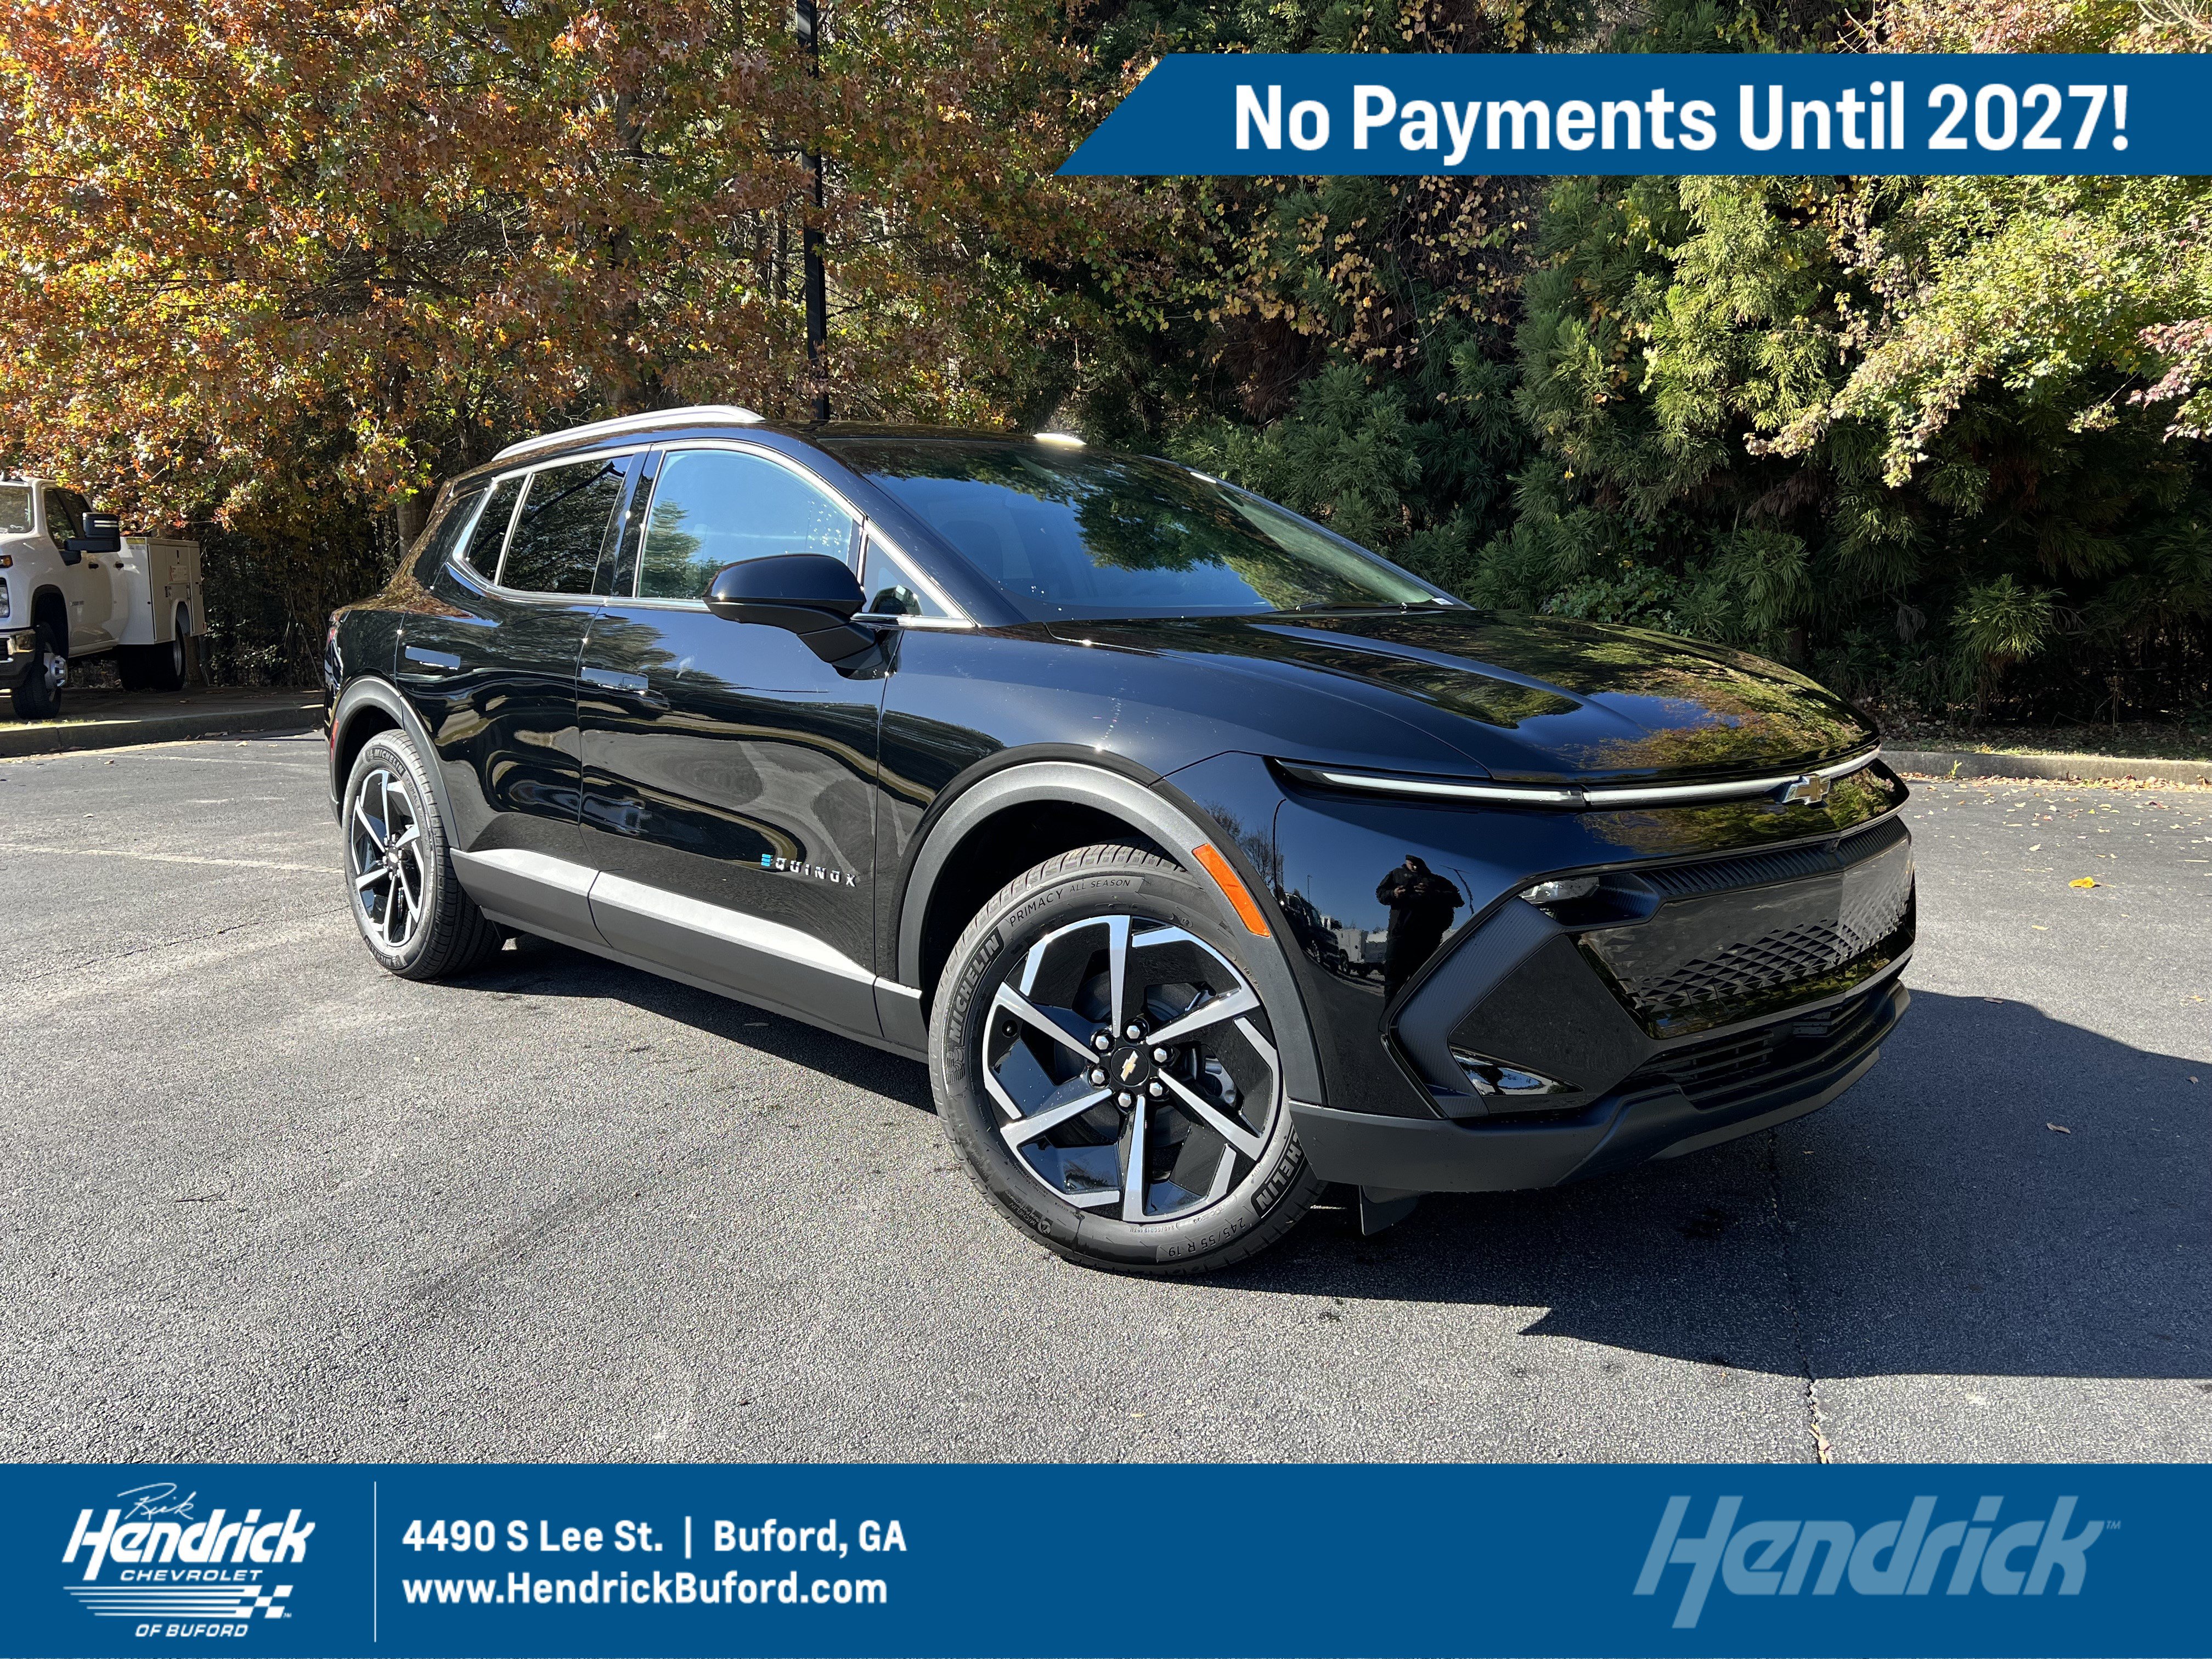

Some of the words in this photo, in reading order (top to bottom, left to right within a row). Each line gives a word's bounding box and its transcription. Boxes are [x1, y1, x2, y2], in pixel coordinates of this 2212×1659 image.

[374, 749, 404, 774] MICHELIN
[761, 854, 856, 887] EQUINOX
[1010, 889, 1063, 927] PRIMACY
[1070, 883, 1086, 892] ALL
[1091, 879, 1131, 888] SEASON
[949, 934, 1000, 1043] MICHELIN
[1009, 1201, 1037, 1226] MICHELIN
[1201, 1217, 1246, 1249] 245/55
[1169, 1246, 1181, 1257] 19
[1188, 1242, 1196, 1254] R
